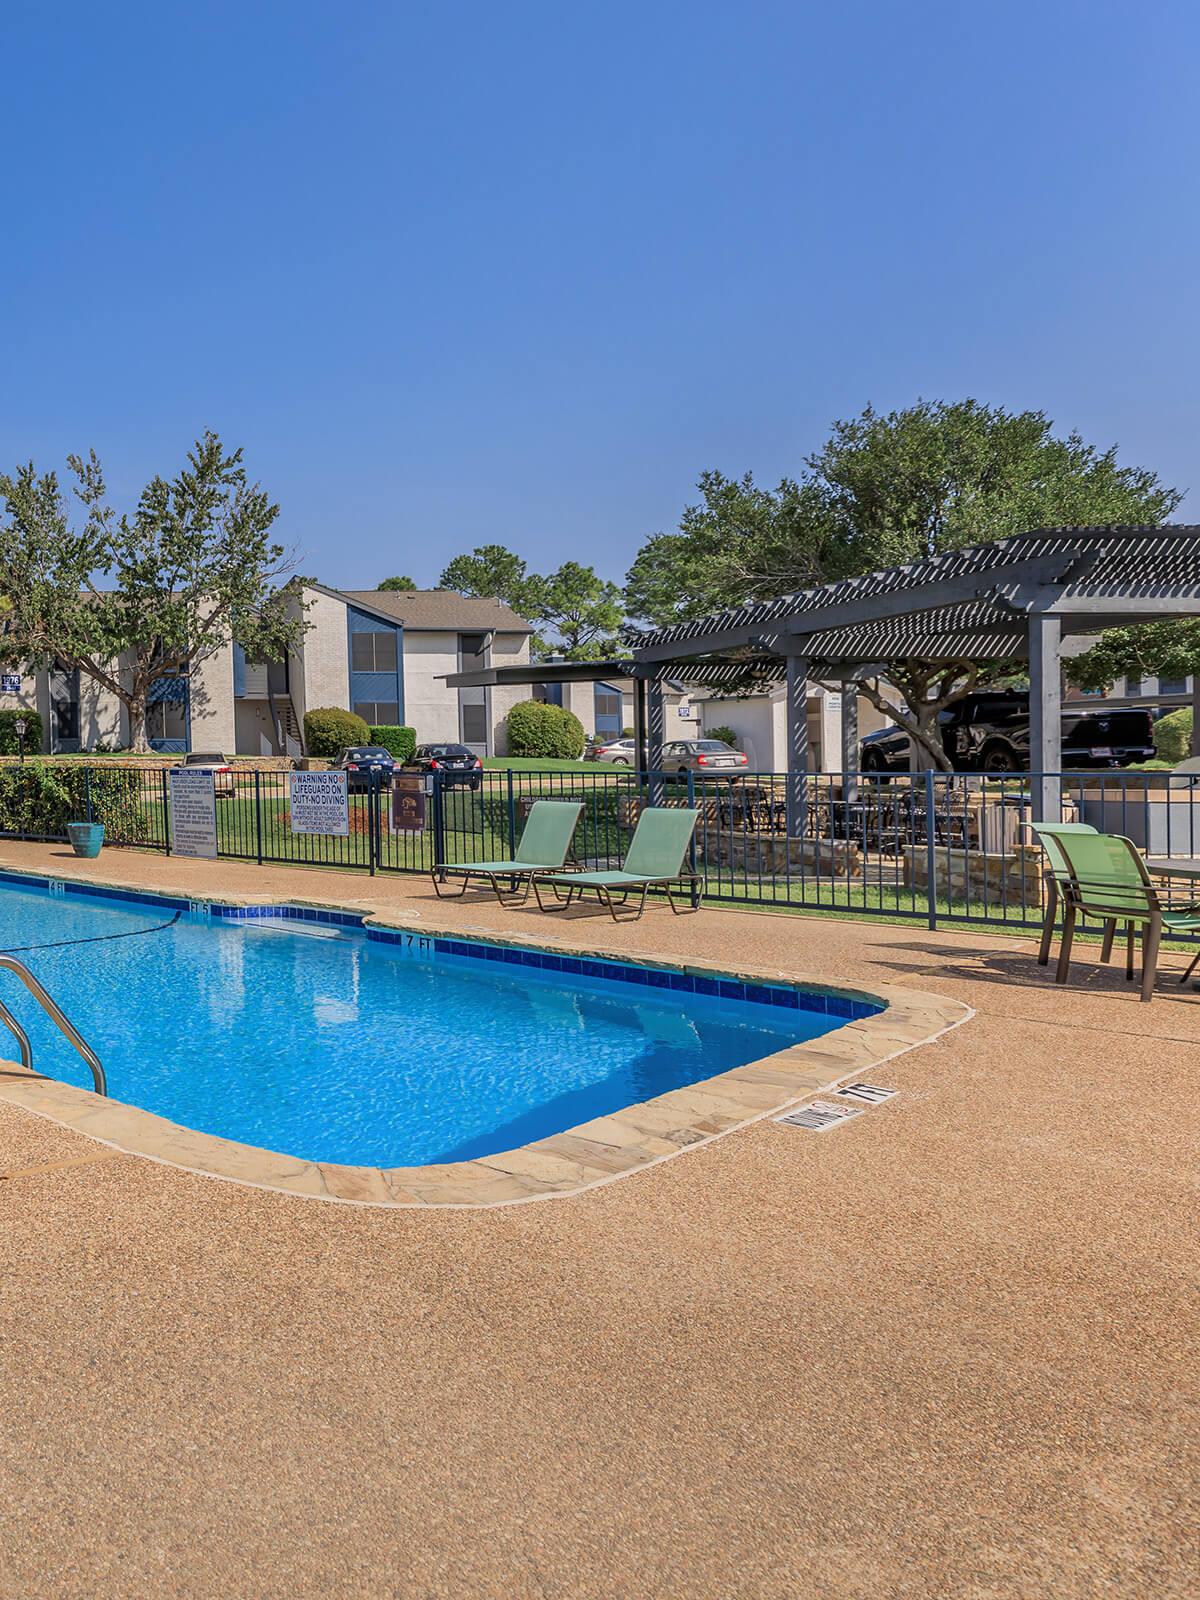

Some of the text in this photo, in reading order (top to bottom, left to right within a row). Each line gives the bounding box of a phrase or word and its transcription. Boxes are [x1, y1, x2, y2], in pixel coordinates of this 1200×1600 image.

[297, 774, 338, 784] WARNING NO
[295, 784, 341, 794] LIFEGUARD ON
[293, 795, 344, 805] DUTY-NO DIVING
[406, 935, 431, 949] 7 FT
